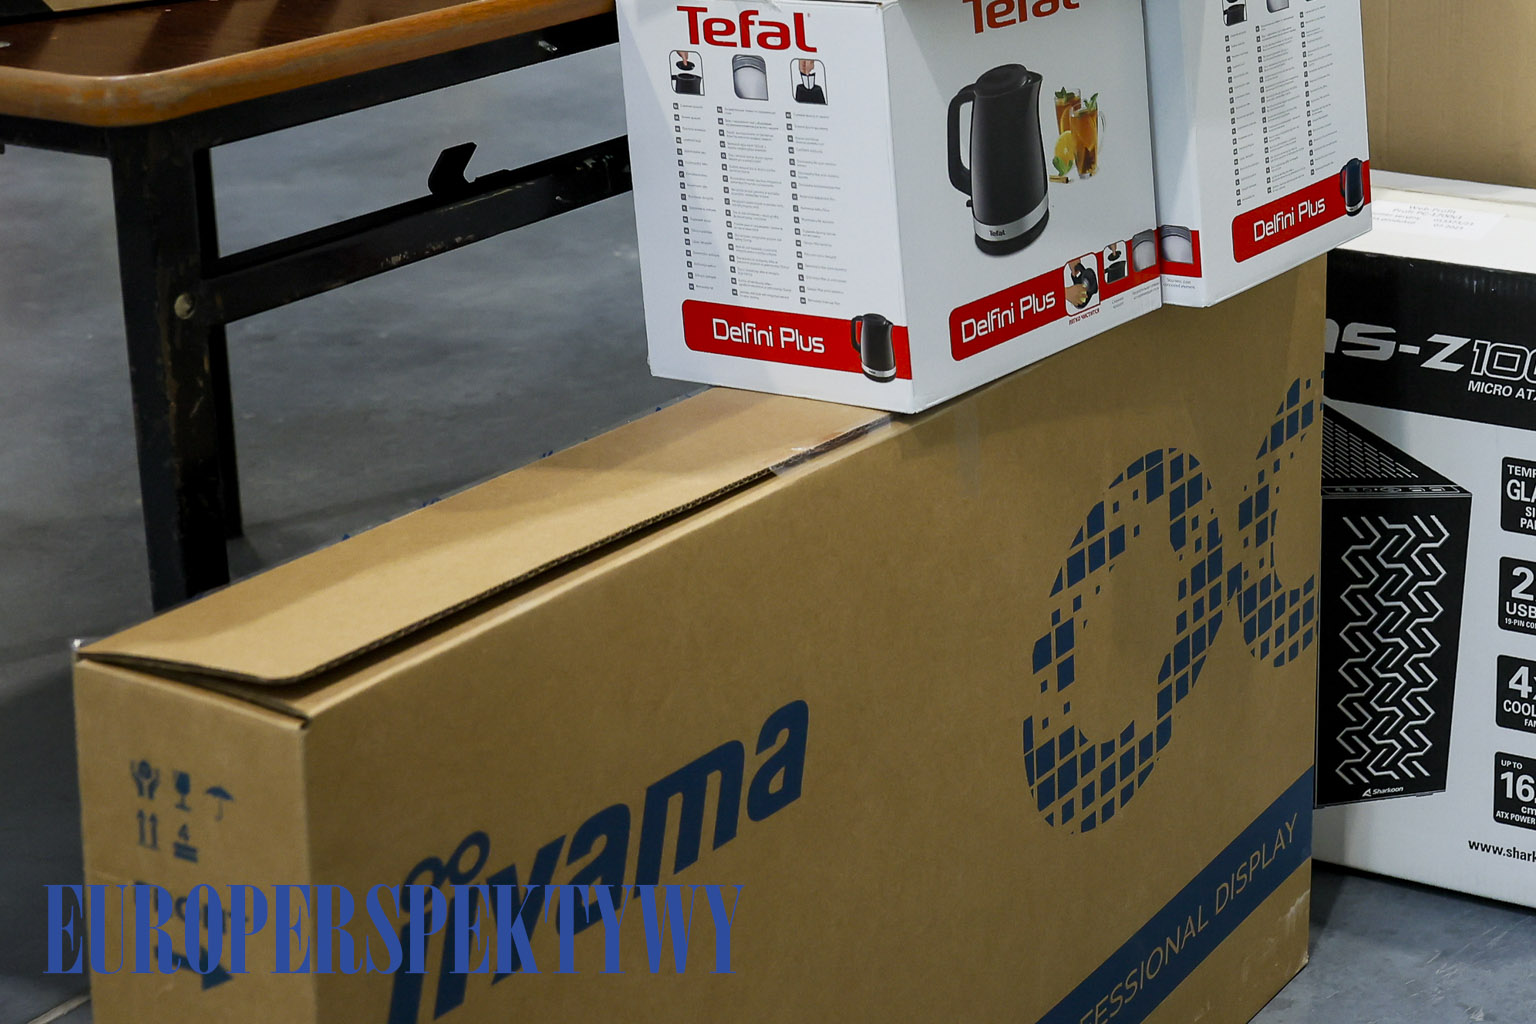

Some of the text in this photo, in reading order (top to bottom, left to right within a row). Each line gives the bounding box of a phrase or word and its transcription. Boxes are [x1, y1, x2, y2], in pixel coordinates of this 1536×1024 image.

[677, 5, 817, 53] Tefal
[1254, 198, 1326, 242] Delfini Plus
[961, 291, 1056, 343] Delfini Plus
[712, 318, 825, 354] Delfini Plus
[1468, 380, 1512, 397] MICRO
[1505, 617, 1524, 629] 19-PIN
[1501, 760, 1523, 770] UP TO
[1372, 786, 1404, 795] Sharkoon
[1496, 810, 1509, 819] ATX
[1510, 813, 1536, 824] POWER
[1521, 806, 1536, 815] cm
[1215, 812, 1298, 915] DISPLAY
